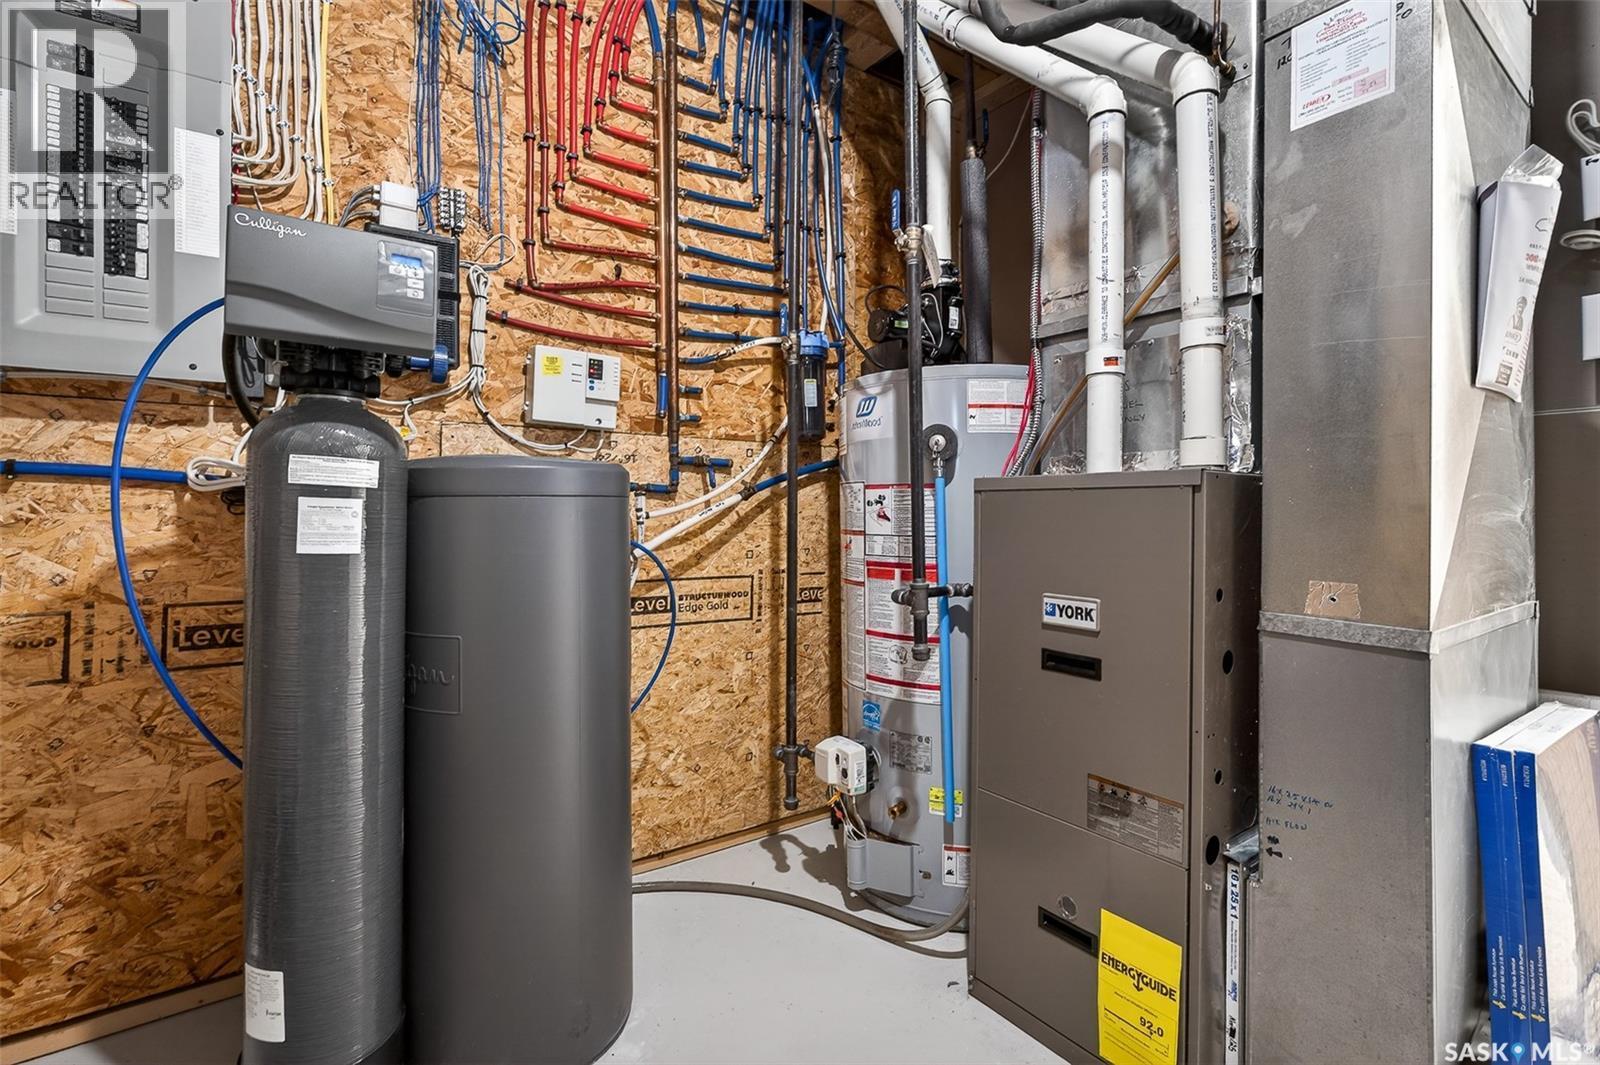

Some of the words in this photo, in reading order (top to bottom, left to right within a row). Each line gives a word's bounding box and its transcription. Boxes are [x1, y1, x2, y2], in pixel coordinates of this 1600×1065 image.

[234, 212, 307, 238] Culligan
[631, 597, 670, 612] evel
[678, 602, 704, 614] Edge
[706, 600, 729, 611] Gold
[1057, 604, 1096, 622] YORK
[1101, 952, 1177, 1002] ENERGYGUIDE
